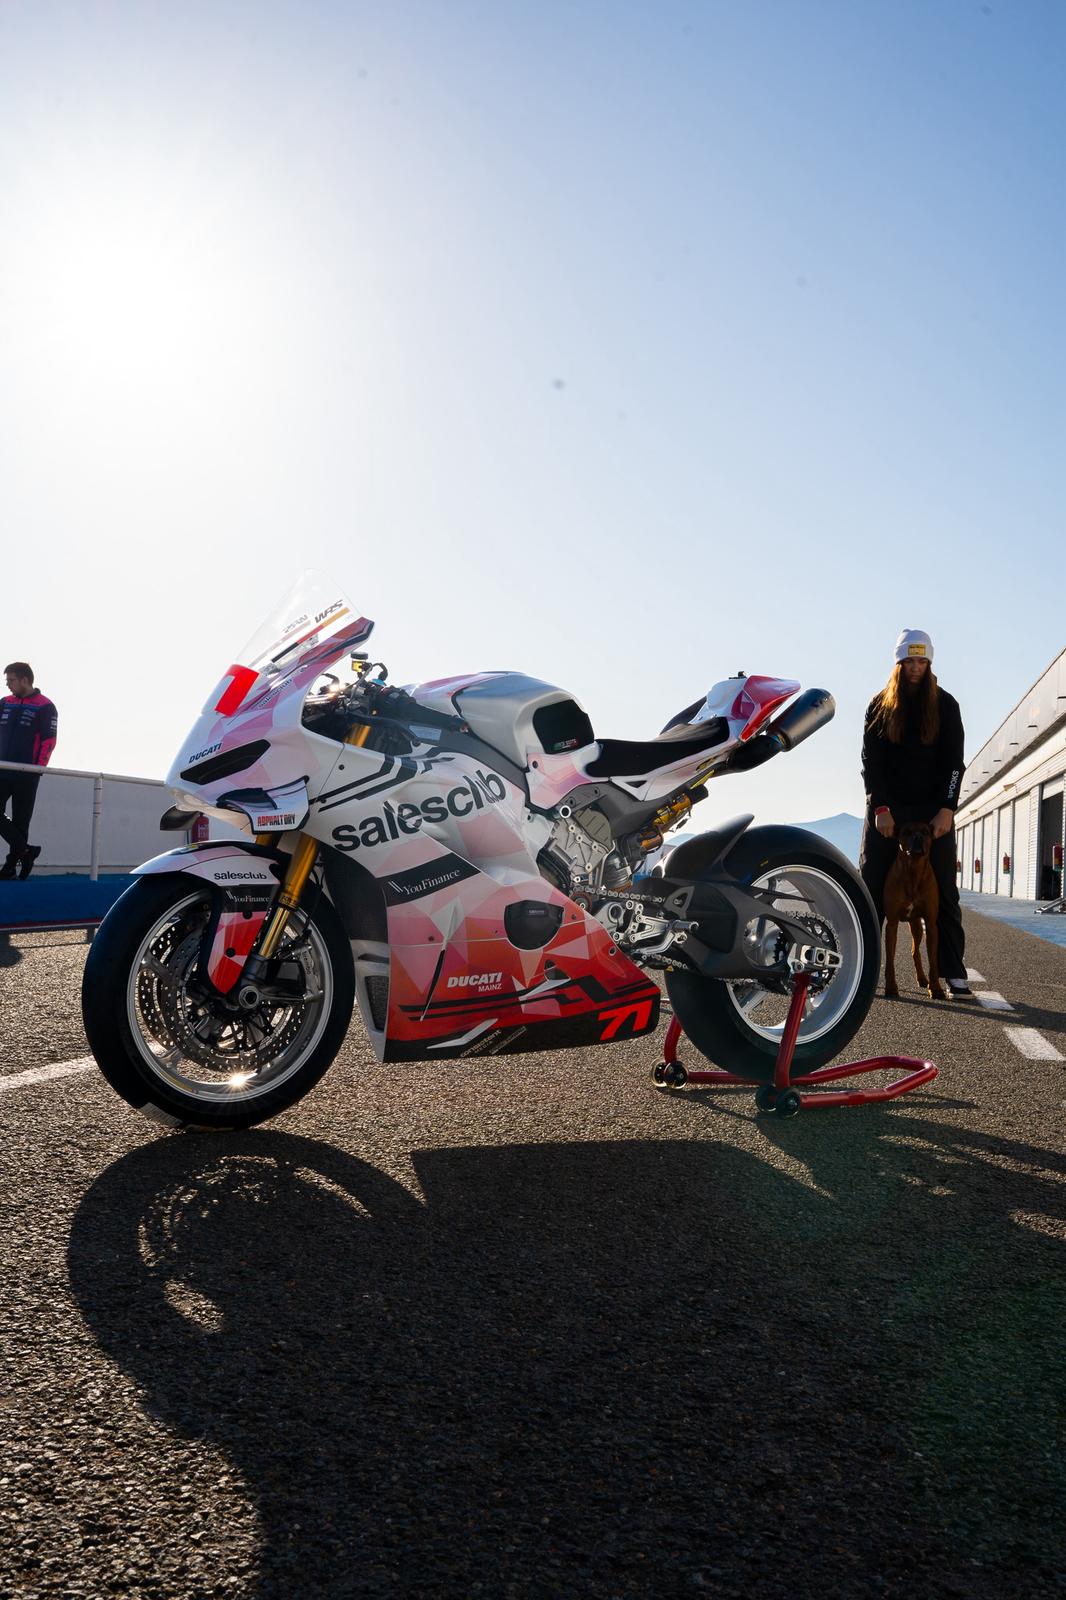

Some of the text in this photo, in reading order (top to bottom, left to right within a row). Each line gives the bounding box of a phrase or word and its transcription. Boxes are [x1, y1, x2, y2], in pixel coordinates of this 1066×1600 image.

[314, 599, 344, 624] WRS
[188, 742, 222, 764] DUCATI
[214, 871, 268, 880] salesclub
[403, 869, 461, 896] YouFinance
[447, 971, 503, 988] DUCATI
[478, 983, 502, 993] MAINZ
[597, 1000, 654, 1041] 71
